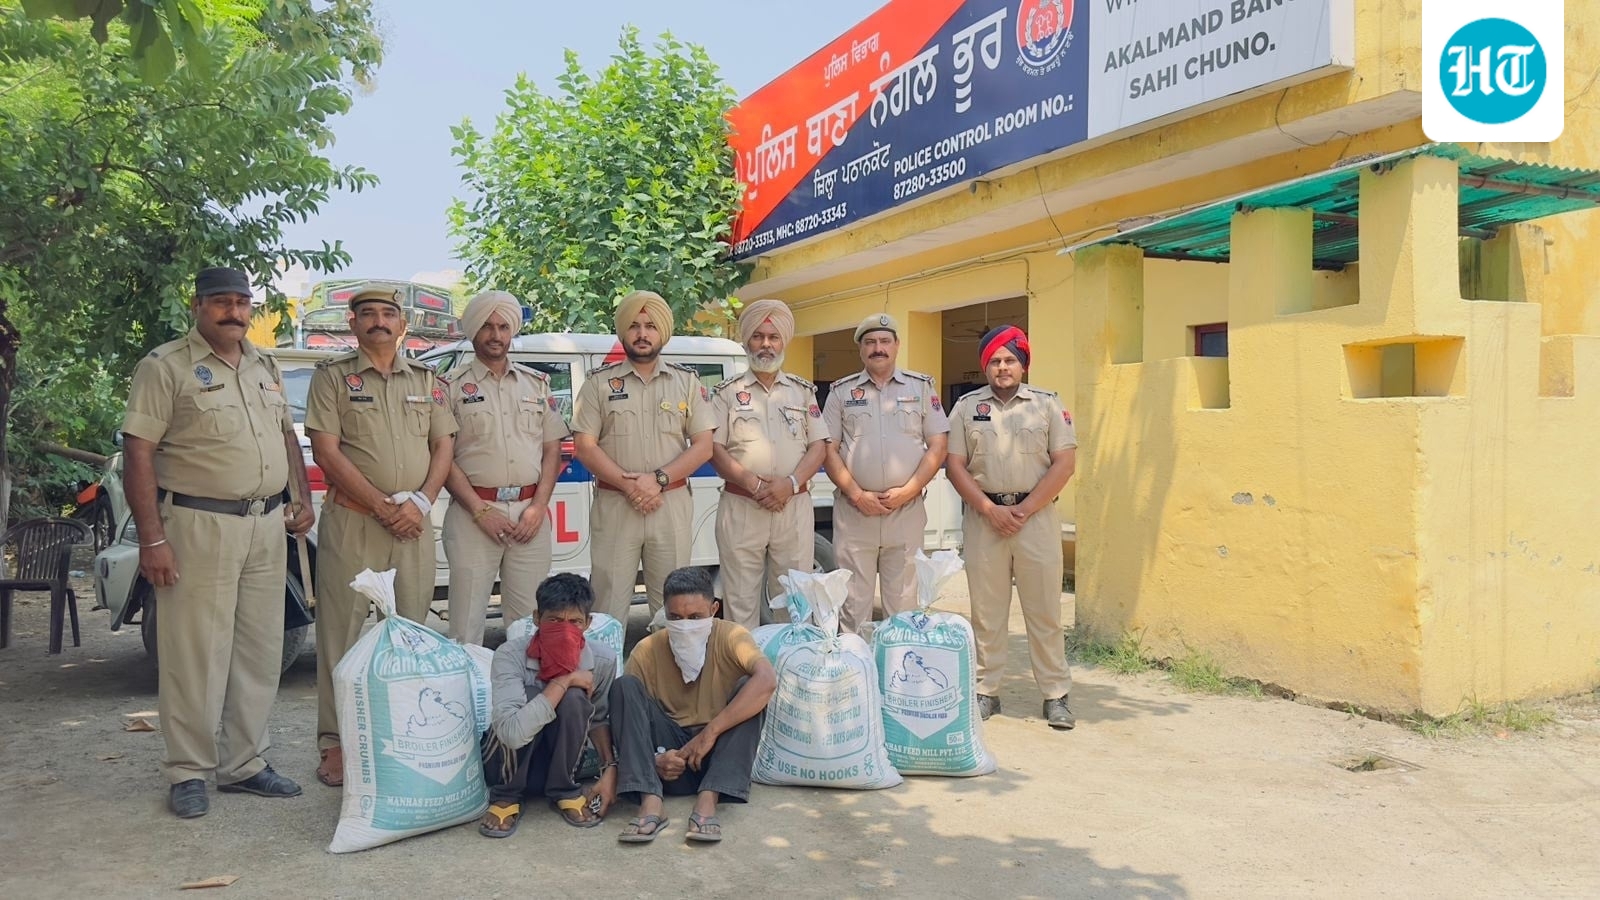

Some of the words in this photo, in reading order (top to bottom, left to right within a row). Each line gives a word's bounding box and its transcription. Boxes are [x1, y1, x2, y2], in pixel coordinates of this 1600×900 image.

[1104, 9, 1224, 73] AKALMAND
[1129, 64, 1177, 99] SAHI
[1184, 31, 1276, 80] CHUNO.
[746, 123, 798, 200] ਪੁਲਿਸ
[806, 92, 859, 157] ਥਾਣਾ
[869, 45, 939, 129] ਨੰਗਲ
[952, 7, 1008, 114] ਭੂਰ
[893, 145, 932, 178] POLICE
[934, 122, 992, 160] CONTROL
[995, 103, 1037, 137] ROOM
[1041, 94, 1073, 121] NO.:
[841, 140, 891, 185] ਪਠਾਨਕੋਟ
[893, 157, 966, 200] 87280-33500
[776, 223, 794, 241] MHC:
[795, 202, 847, 235] 88720-33343
[888, 694, 919, 709] BROILER
[921, 693, 954, 708] FINISHER
[358, 734, 371, 784] CRUMBS
[398, 739, 438, 752] BROILER
[903, 746, 921, 756] FEED
[922, 748, 939, 757] MILL
[939, 748, 954, 757] PVT.
[778, 760, 797, 776] USE
[800, 767, 815, 780] NO
[820, 765, 859, 780] HOOKS
[386, 796, 423, 808] MANHAS
[424, 797, 443, 807] FEED
